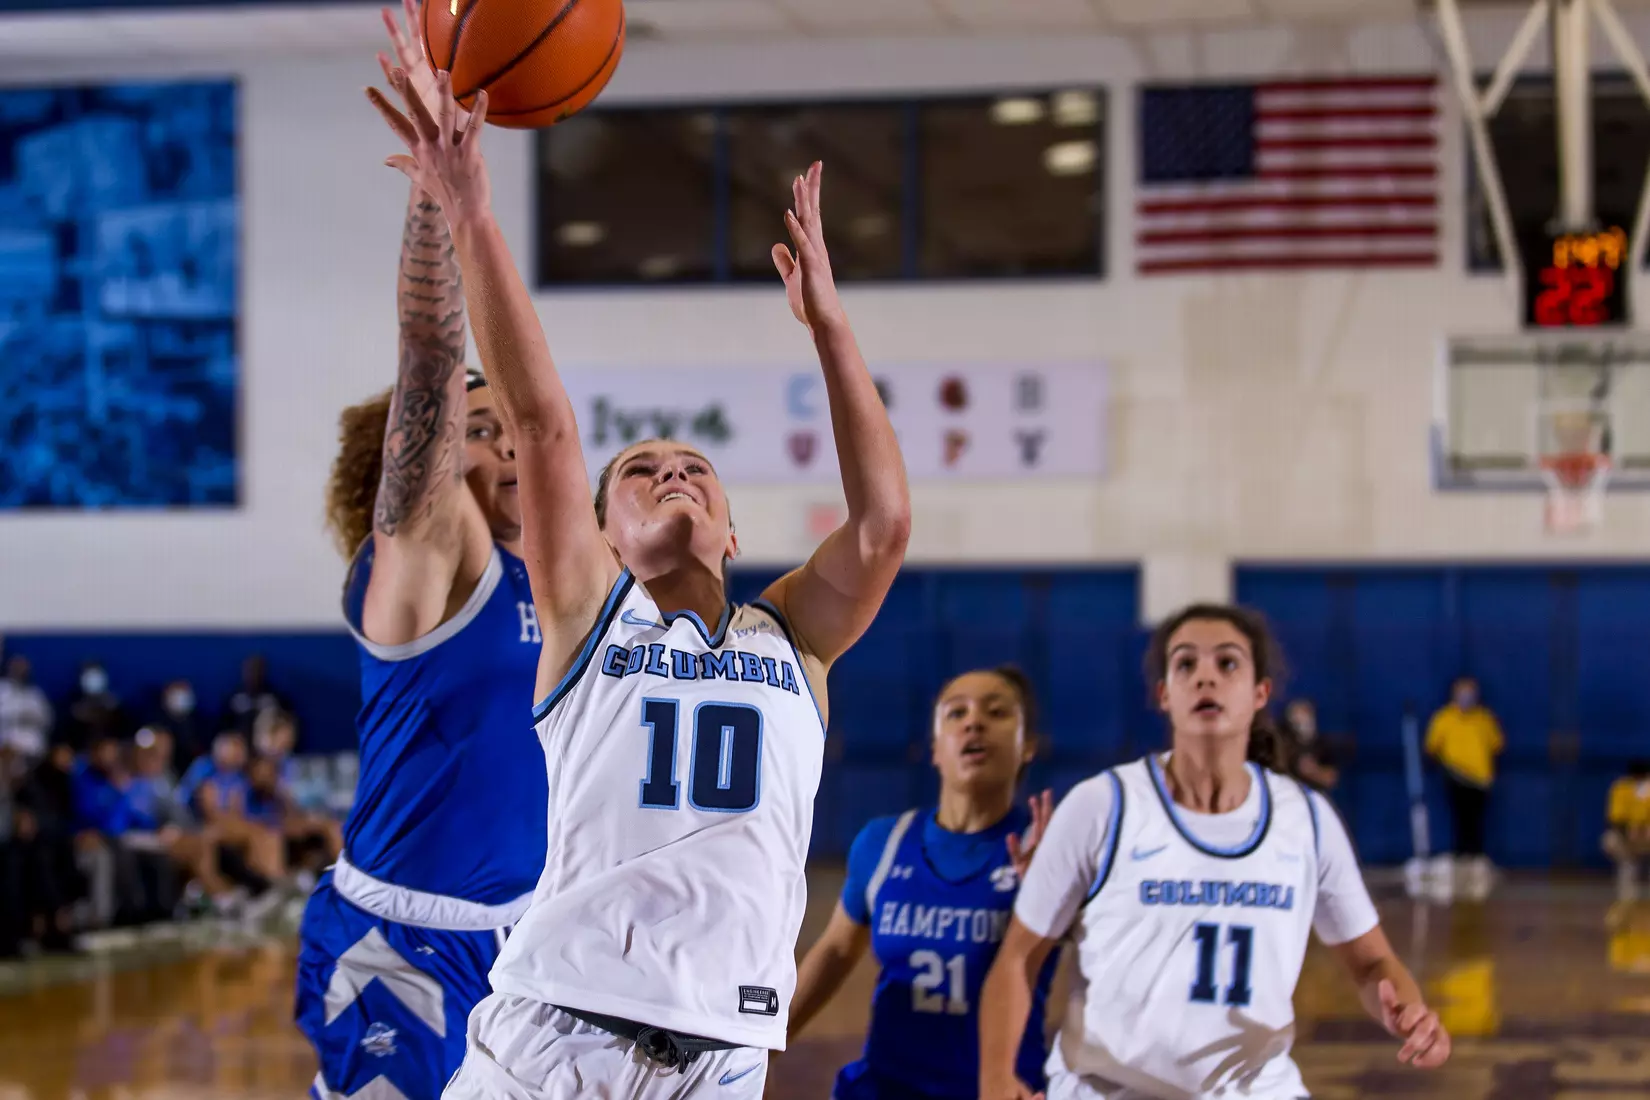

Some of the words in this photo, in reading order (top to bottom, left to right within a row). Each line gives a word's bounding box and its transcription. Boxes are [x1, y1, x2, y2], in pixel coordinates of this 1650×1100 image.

[601, 643, 799, 696] COLUMBIA
[638, 696, 764, 813] 10
[909, 949, 969, 1015] 21
[1187, 921, 1255, 1006] 11
